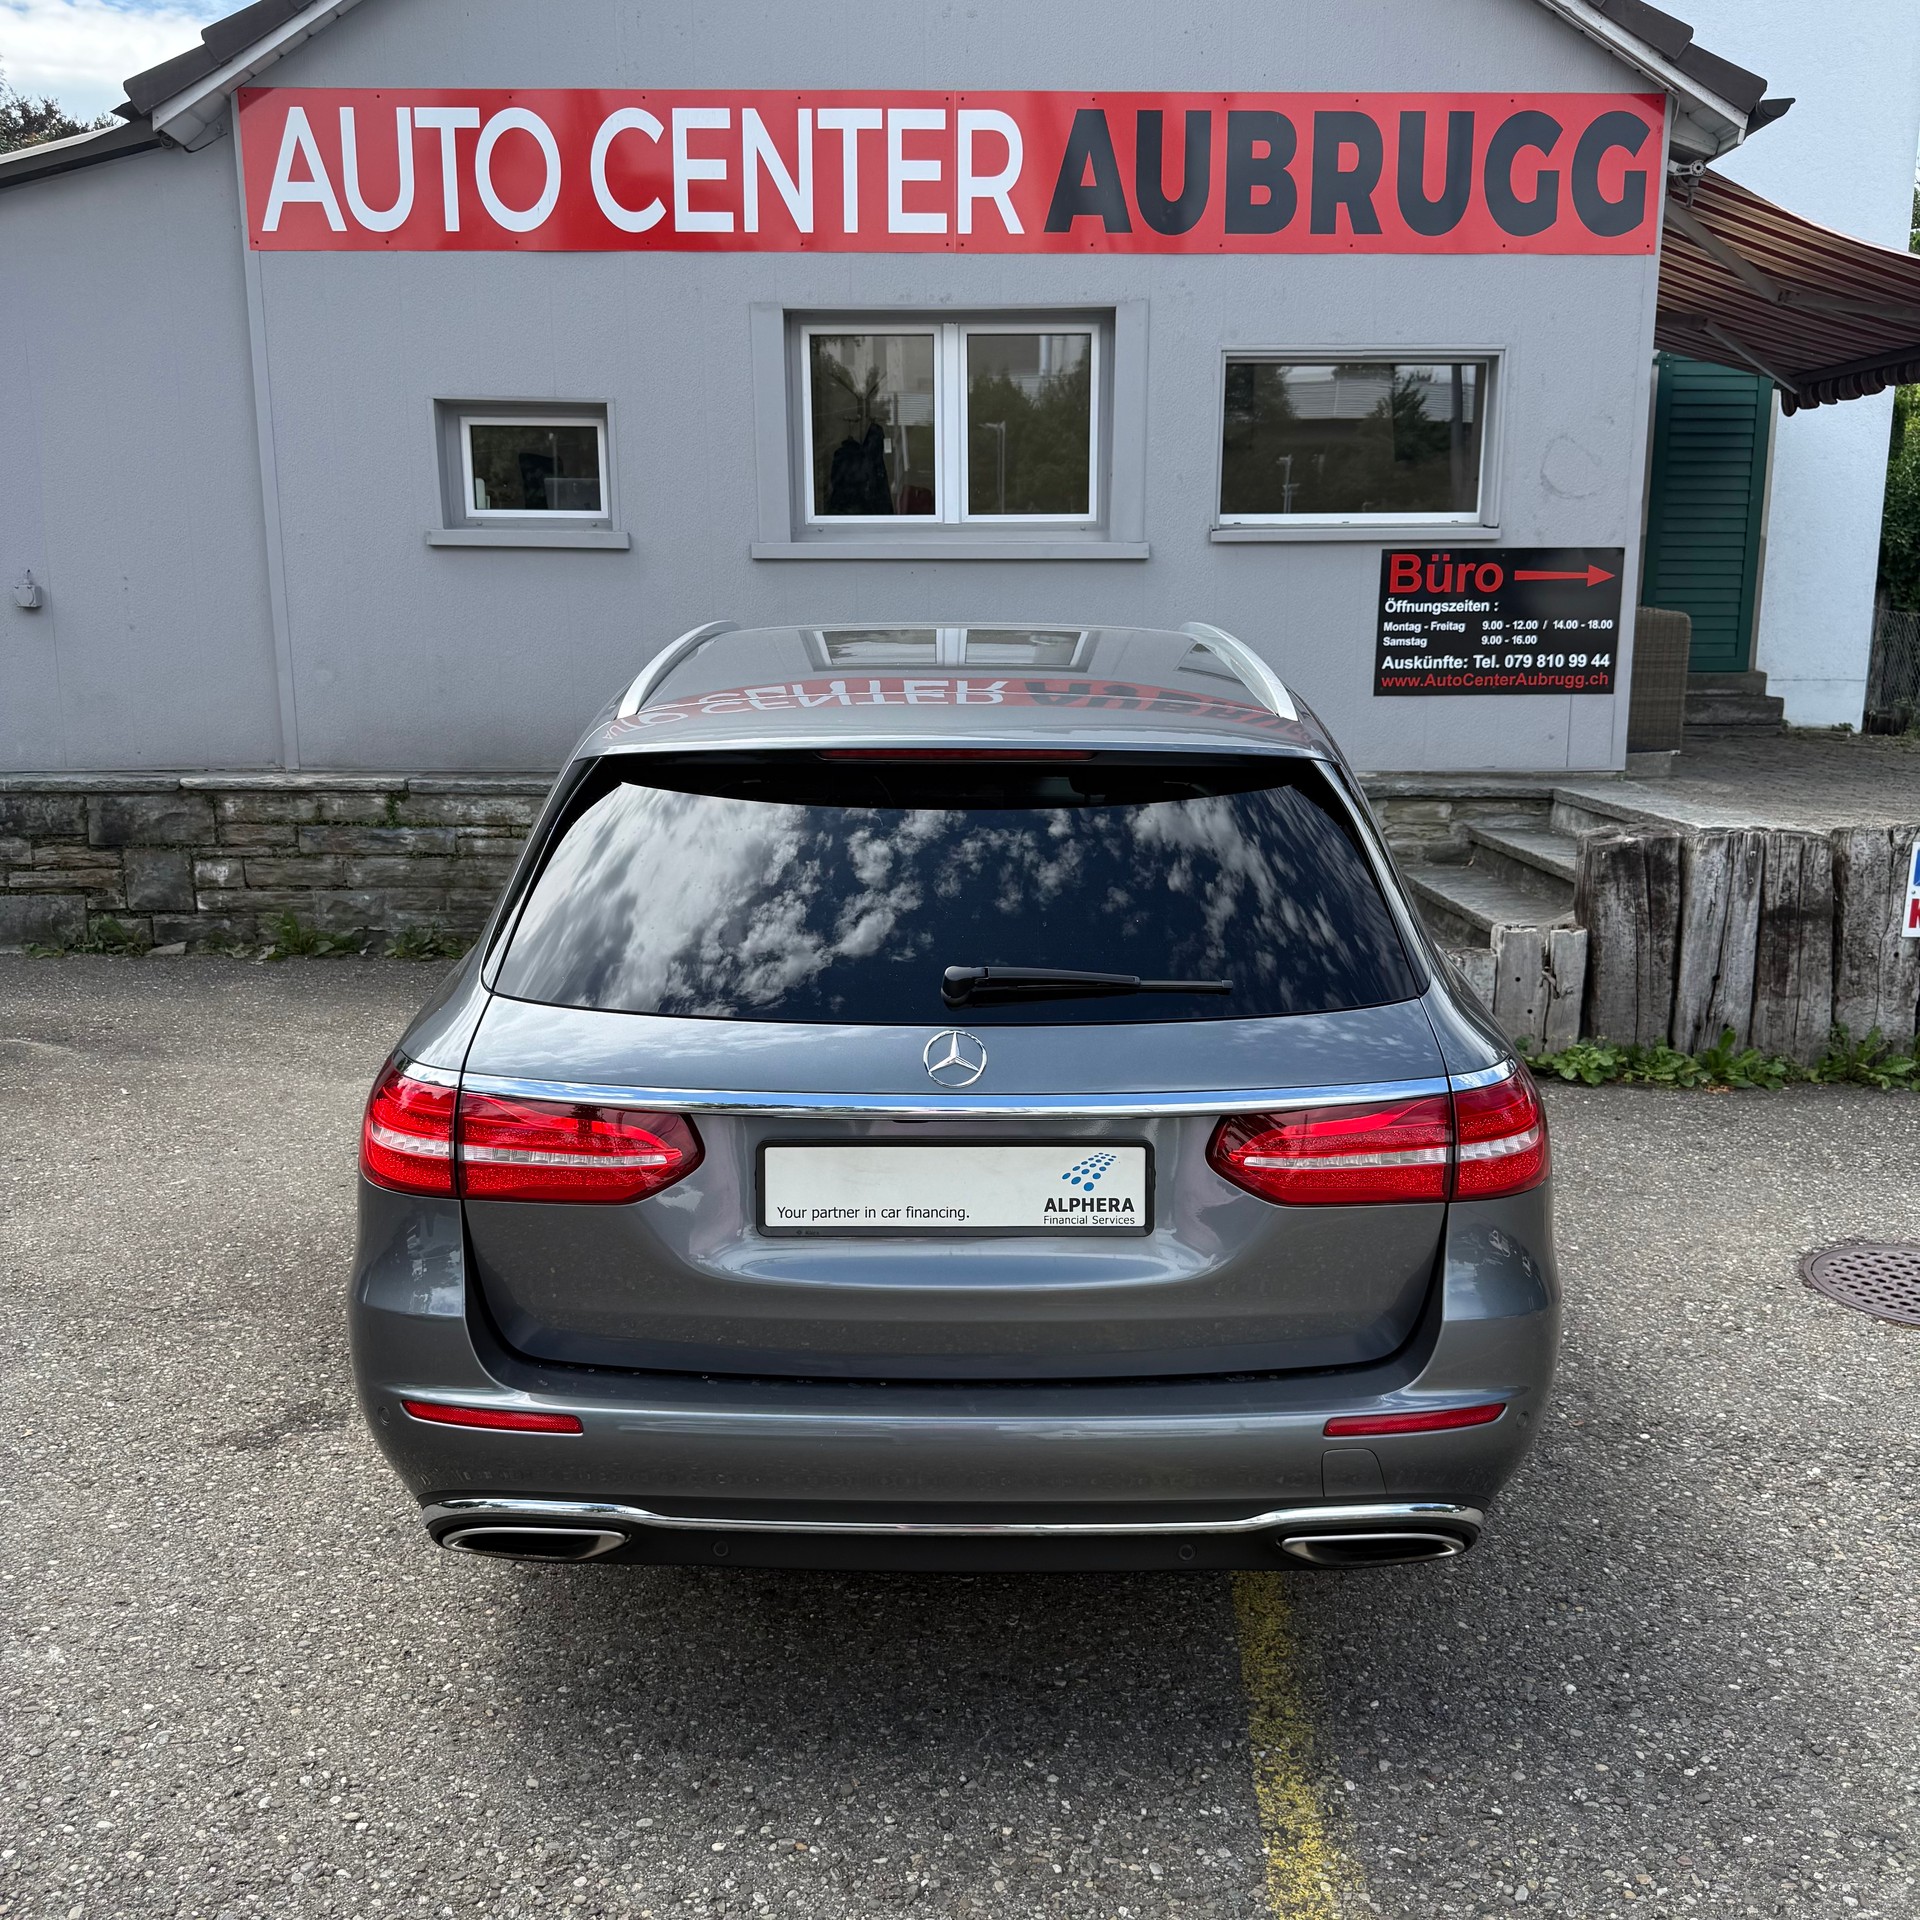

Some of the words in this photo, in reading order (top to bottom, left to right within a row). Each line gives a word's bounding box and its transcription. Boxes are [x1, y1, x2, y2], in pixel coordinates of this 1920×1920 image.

[261, 106, 562, 233] AUTO
[590, 107, 1025, 236] CENTER
[1044, 109, 1651, 237] AUBRUGG
[1388, 553, 1504, 593] Büro
[1384, 597, 1490, 615] Öffnungszeiten
[1383, 621, 1422, 633] Montag
[1430, 620, 1466, 633] Freitag
[1482, 620, 1503, 631] 9.00
[1512, 619, 1539, 630] 12.00
[1552, 619, 1579, 630] 14.00
[1587, 619, 1613, 630] 18.00
[1382, 636, 1428, 648] Samstag
[1481, 635, 1503, 645] 9.00
[1511, 634, 1538, 645] 16.00
[1381, 654, 1469, 670] Auskünfte:
[1473, 654, 1500, 669] Tel.
[1504, 654, 1533, 669] 079
[1536, 653, 1565, 668] 810
[1568, 653, 1587, 668] 99
[1590, 653, 1610, 668] 44
[1381, 672, 1609, 689] www.AutoCenterAubrugg.ch
[776, 1206, 808, 1219] Your
[811, 1207, 861, 1222] partner
[864, 1206, 876, 1219] in
[880, 1208, 902, 1219] car
[905, 1205, 970, 1222] financing.
[1043, 1197, 1135, 1213] ALPHERA
[1043, 1215, 1088, 1225] Financial
[1092, 1215, 1136, 1225] Services
